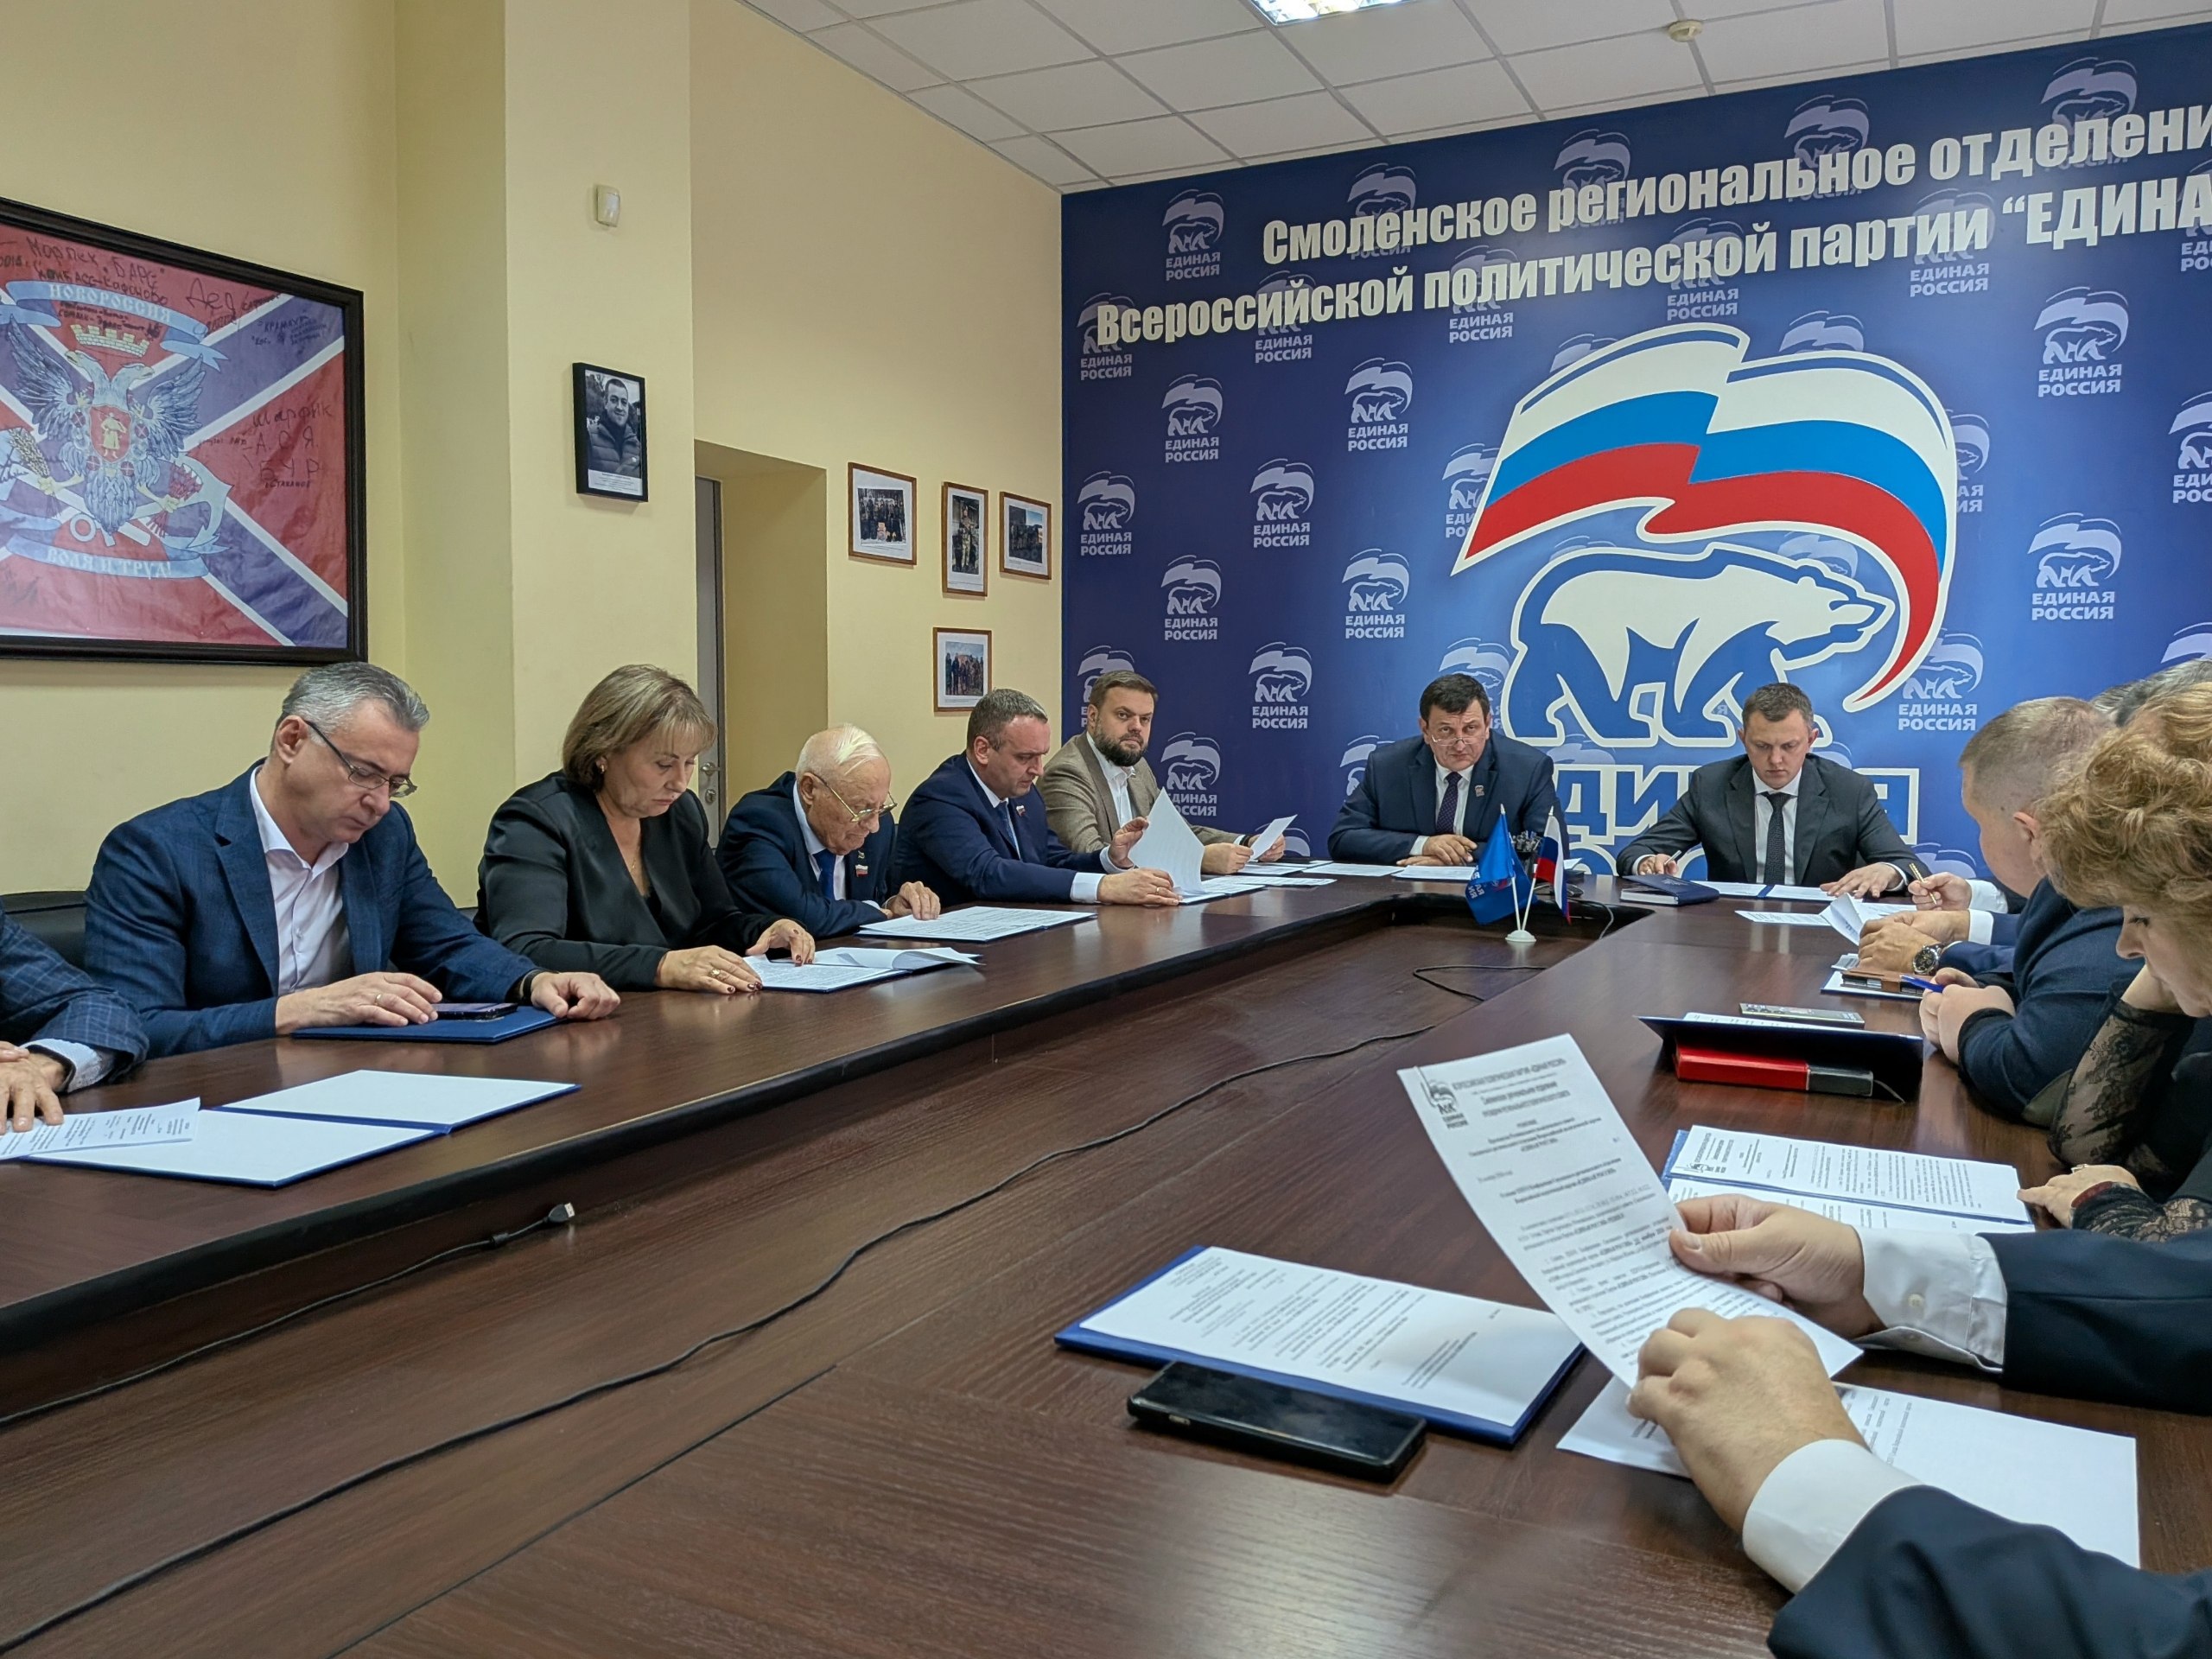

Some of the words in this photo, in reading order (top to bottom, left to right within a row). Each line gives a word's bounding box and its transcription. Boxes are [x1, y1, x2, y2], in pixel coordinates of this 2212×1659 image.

[1263, 192, 1536, 264] Смоленское
[1548, 143, 1915, 233] региональное
[1929, 104, 2212, 181] отделени
[1166, 251, 1220, 269] ЕДИНАЯ
[1096, 266, 1413, 348] Всероссийской
[1424, 222, 1777, 310] политической
[1789, 208, 1989, 270] партии
[1166, 264, 1220, 281] РОССИЯ
[1910, 263, 1990, 283] ЕДИНАЯ
[1910, 277, 1988, 297] РОССИЯ
[1667, 288, 1739, 307] ЕДИНАЯ
[1667, 302, 1738, 321] РОССИЯ
[1449, 312, 1514, 330] ЕДИНАЯ
[1255, 334, 1313, 351] ЕДИНАЯ
[1449, 326, 1513, 343] РОССИЯ
[1080, 353, 1132, 369] ЕДИНАЯ
[1255, 347, 1312, 364] РОССИЯ
[1080, 365, 1132, 380] РОССИЯ
[2038, 364, 2122, 383] ЕДИНАЯ
[2037, 379, 2121, 397] РОССИЯ
[1348, 423, 1408, 439] ЕДИНАЯ
[1165, 436, 1219, 451] ЕДИНАЯ
[1348, 435, 1408, 452] РОССИЯ
[1165, 448, 1218, 463] РОССИЯ
[1253, 522, 1311, 536] ЕДИНАЯ
[1080, 531, 1132, 544] ЕДИНАЯ
[1253, 534, 1310, 548] РОССИЯ
[1080, 543, 1131, 556] РОССИЯ
[2031, 591, 2115, 607] ЕДИНАЯ
[1345, 613, 1405, 627] ЕДИНАЯ
[2031, 606, 2113, 620] РОССИЯ
[1165, 617, 1218, 630] ЕДИНАЯ
[1165, 629, 1217, 640] РОССИЯ
[1345, 626, 1404, 639] РОССИЯ
[1252, 706, 1308, 717] ЕДИНАЯ
[1898, 703, 1978, 717] ЕДИНАЯ
[1252, 717, 1308, 729] РОССИЯ
[1897, 718, 1976, 731] РОССИЯ
[1168, 793, 1217, 804] ДИНАЯ
